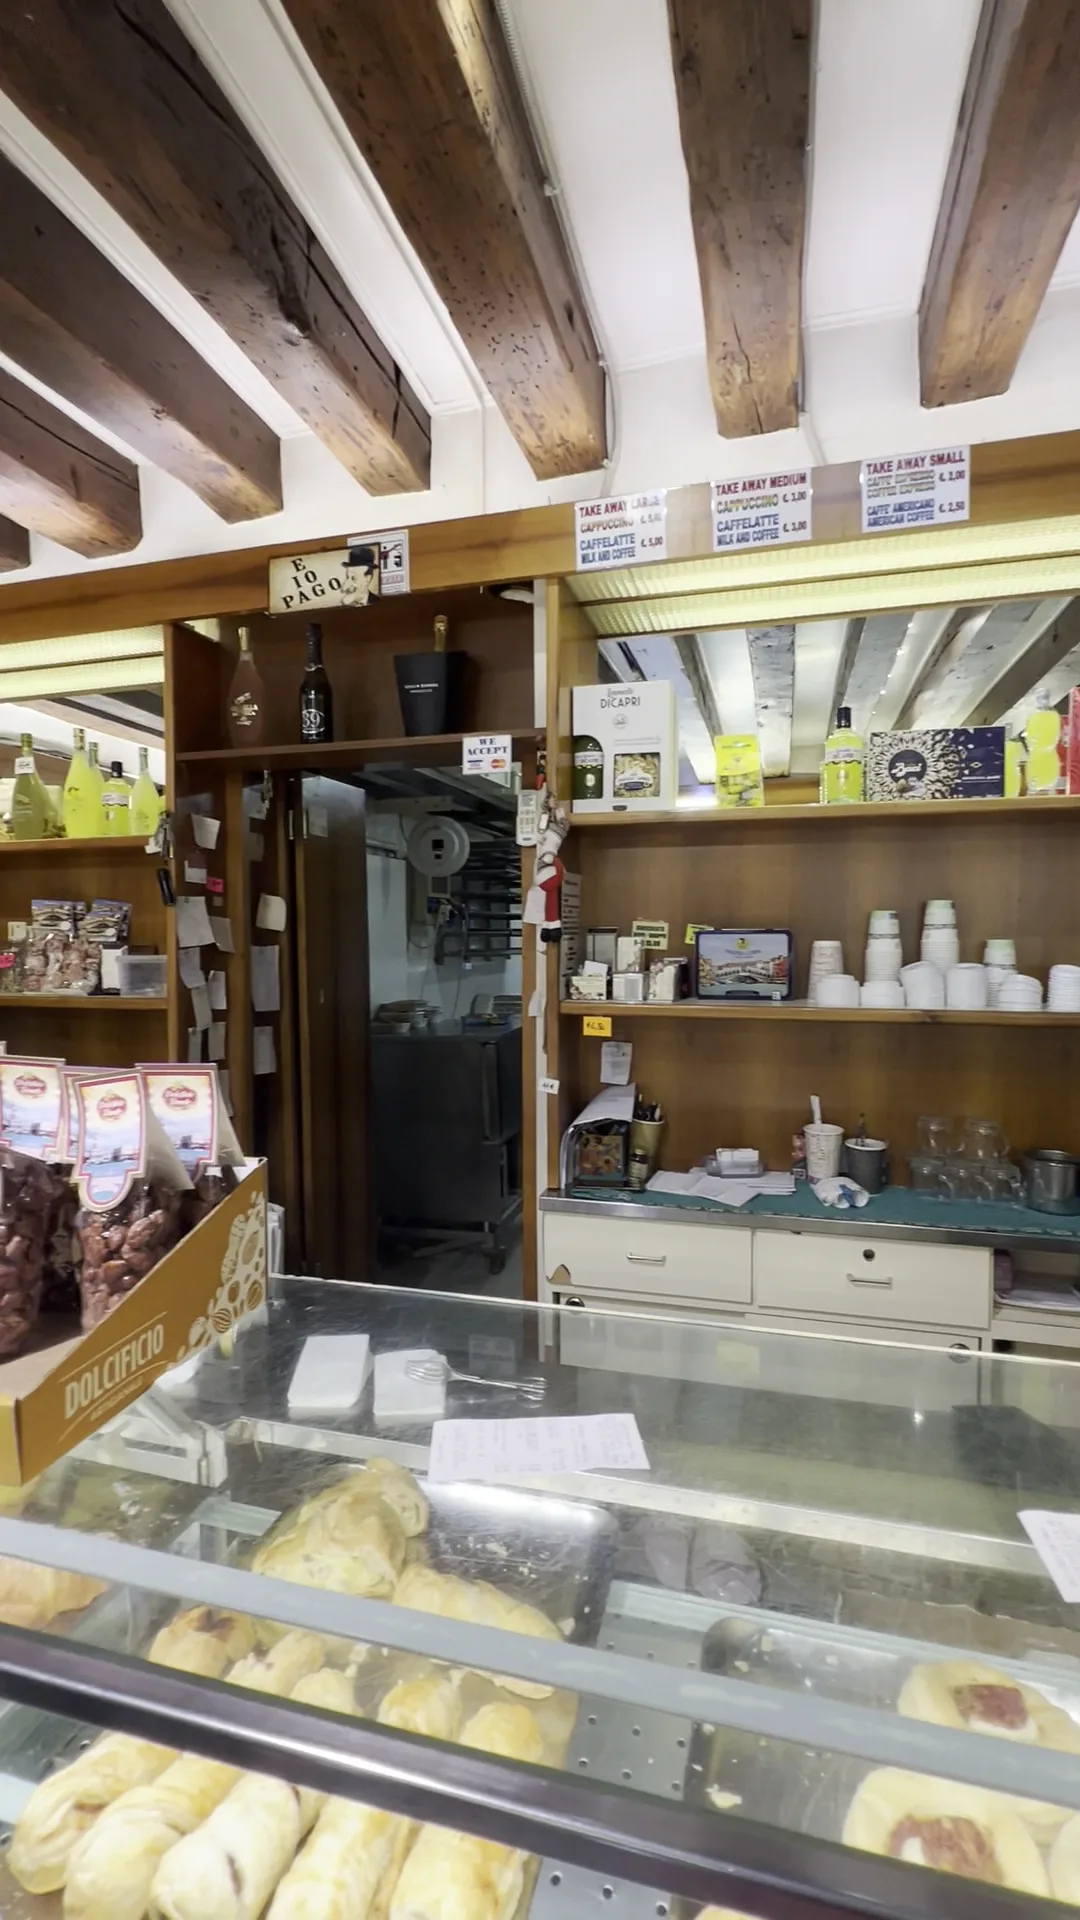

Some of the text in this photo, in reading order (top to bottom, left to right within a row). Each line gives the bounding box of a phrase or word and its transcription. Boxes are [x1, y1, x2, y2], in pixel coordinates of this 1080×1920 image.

[866, 450, 965, 475] TAKE AWAY SMALL
[716, 472, 807, 496] TAKE AWAY MEDIUM
[580, 504, 601, 518] TAKE
[604, 500, 627, 514] AWAY
[716, 513, 779, 532] CAFFELATTE
[580, 533, 635, 551] CAFFELATTE
[717, 527, 779, 546] MILK AND COFFEE
[291, 557, 306, 572] E
[581, 546, 636, 564] MILK AND COFFEE
[292, 570, 317, 589] IO
[281, 577, 342, 610] PAGO
[600, 696, 641, 709] DICAPRI
[467, 746, 508, 756] ACCEPT
[64, 1324, 164, 1420] DOLCIFICIO
